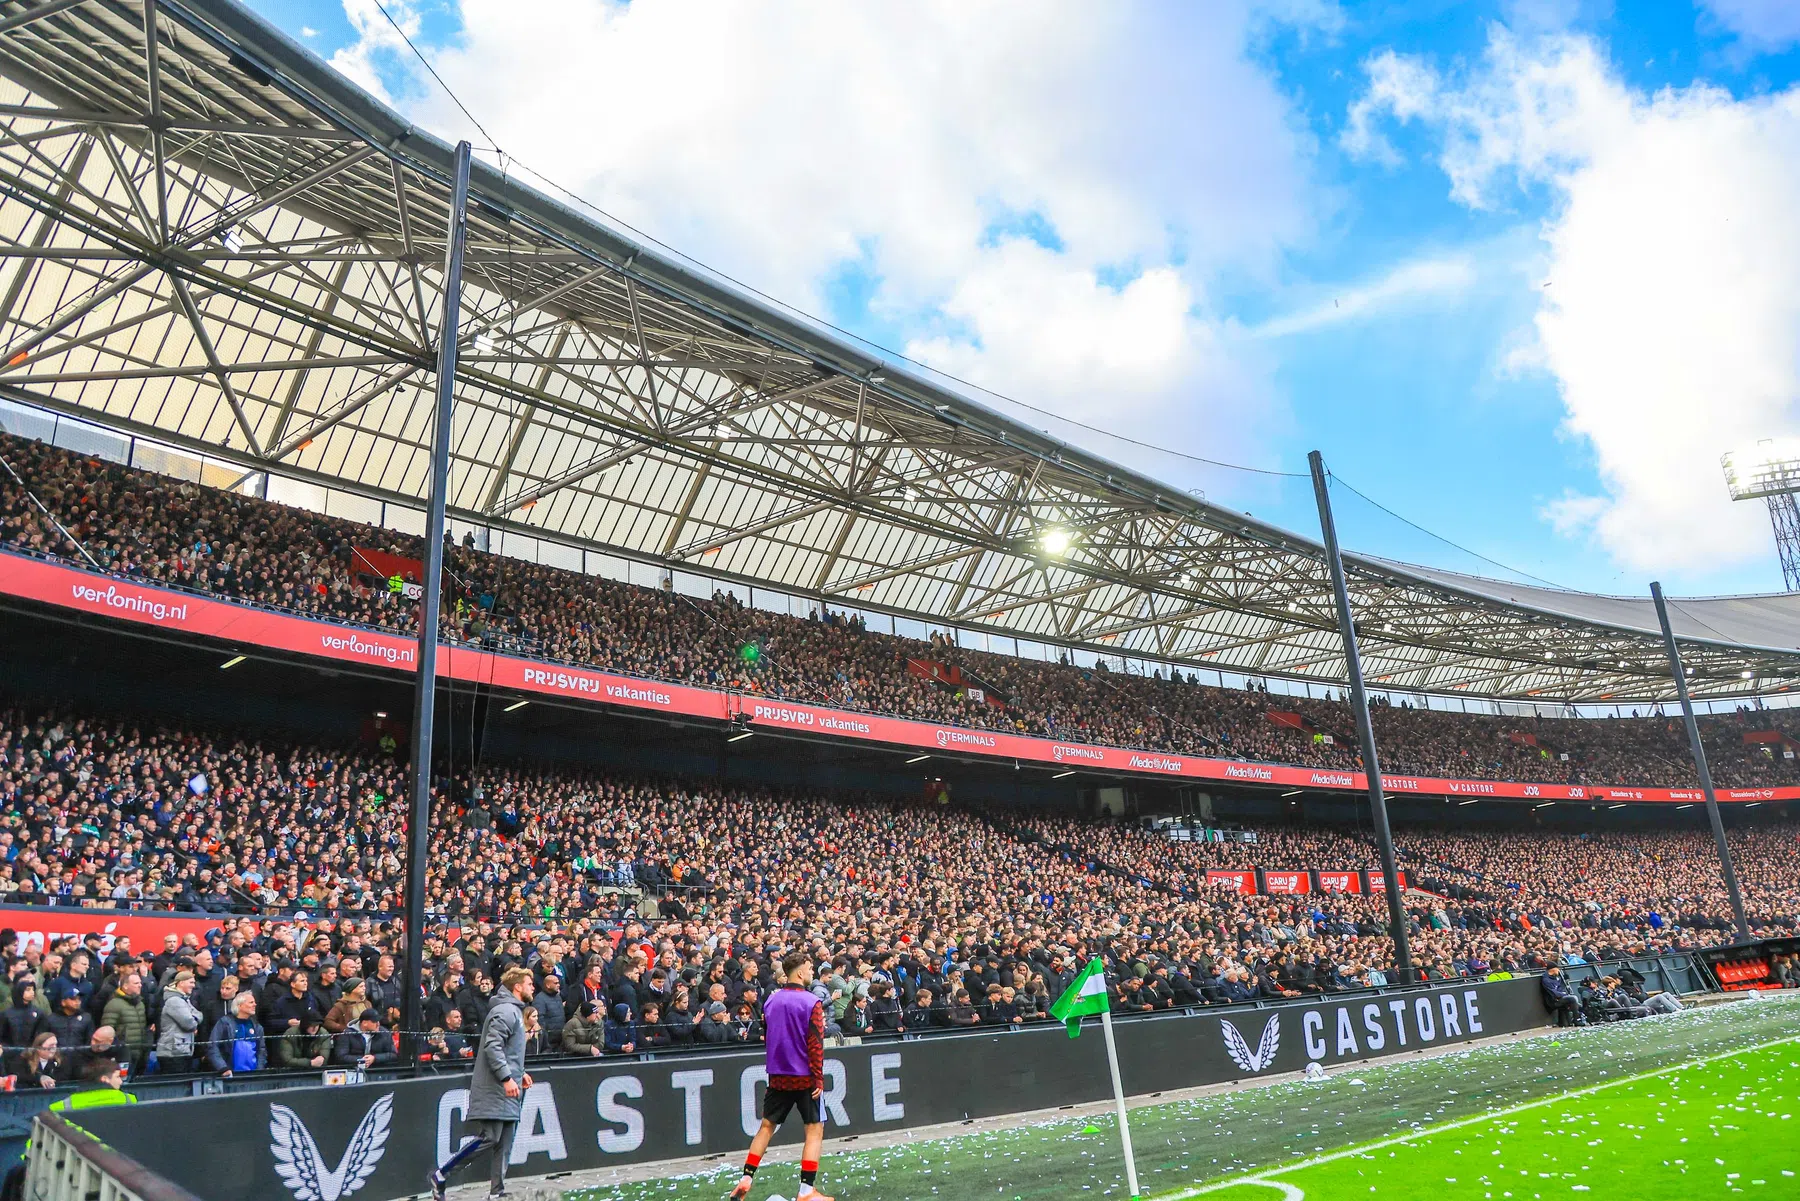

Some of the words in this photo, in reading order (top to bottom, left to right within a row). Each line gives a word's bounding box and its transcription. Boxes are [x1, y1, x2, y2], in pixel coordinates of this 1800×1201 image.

[72, 585, 187, 620] verloning.nl
[322, 634, 414, 662] verloning.nl
[605, 684, 671, 705] vakanties
[818, 717, 870, 733] vakanties
[1382, 778, 1418, 790] CASTORE
[1461, 783, 1494, 793] CASTORE
[1268, 876, 1288, 886] CARU
[1321, 876, 1339, 885] CARU
[1302, 990, 1483, 1060] CASTORE
